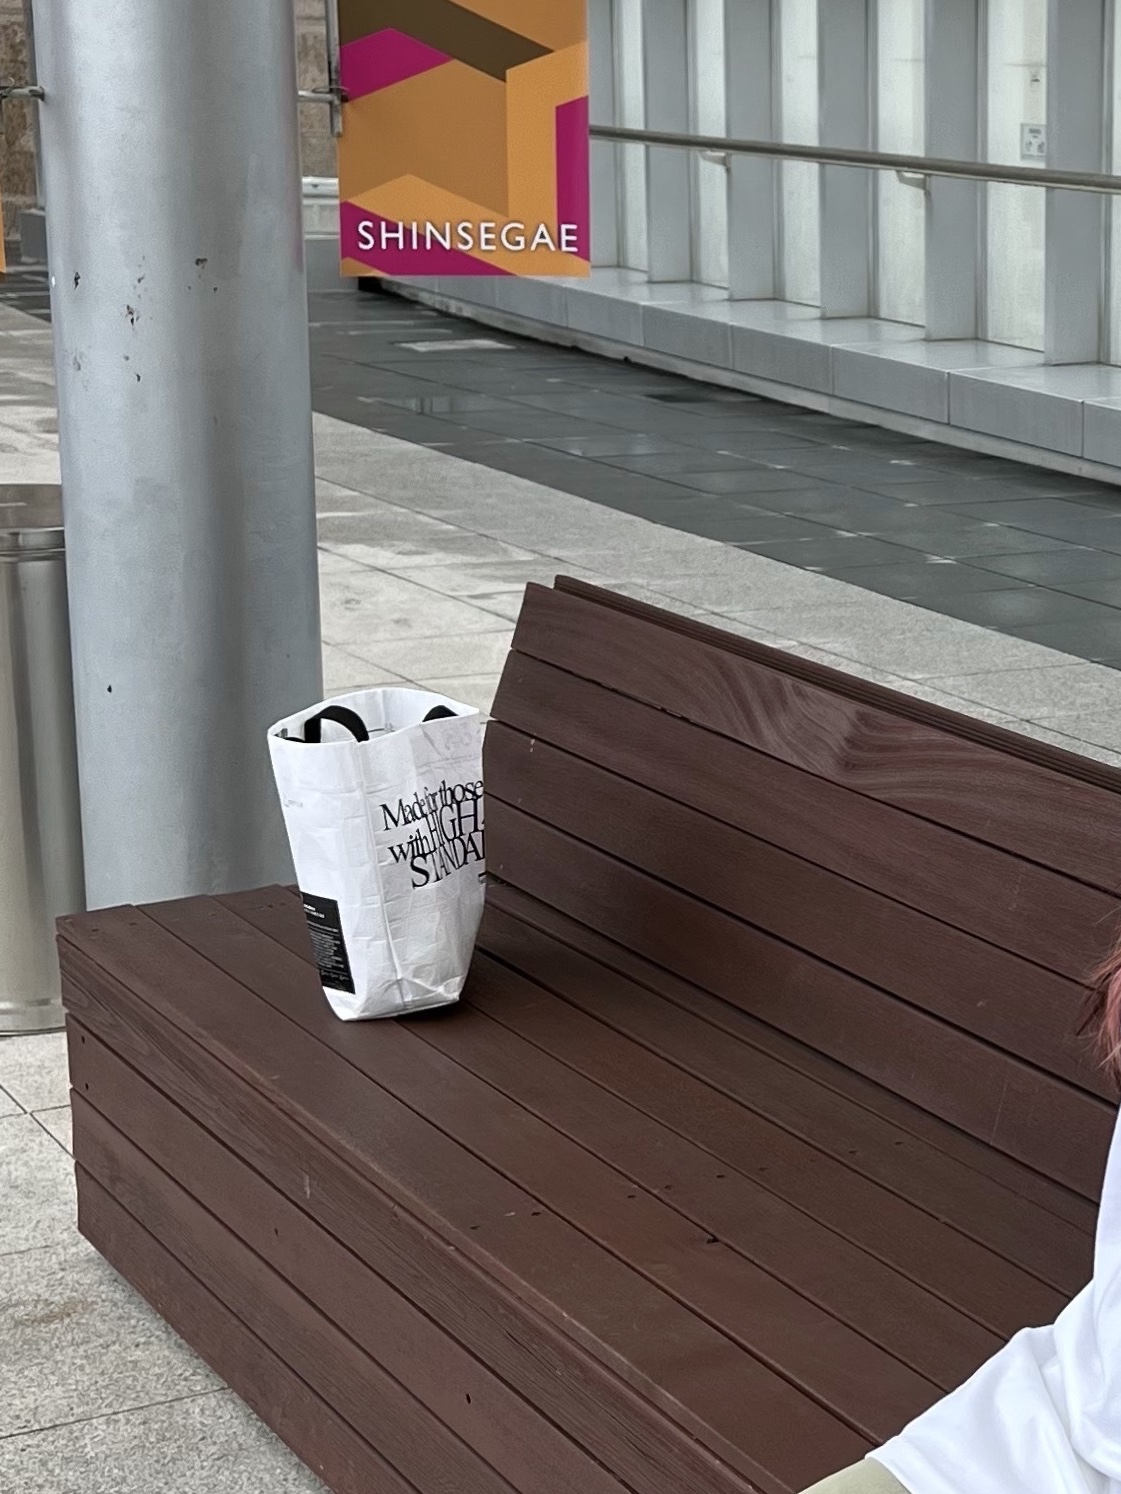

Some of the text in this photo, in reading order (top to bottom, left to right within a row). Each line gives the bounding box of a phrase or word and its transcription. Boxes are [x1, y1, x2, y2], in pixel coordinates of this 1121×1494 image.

[357, 220, 579, 252] SHINSEGAE
[379, 791, 427, 831] Made
[438, 779, 484, 806] those
[387, 827, 431, 864] with
